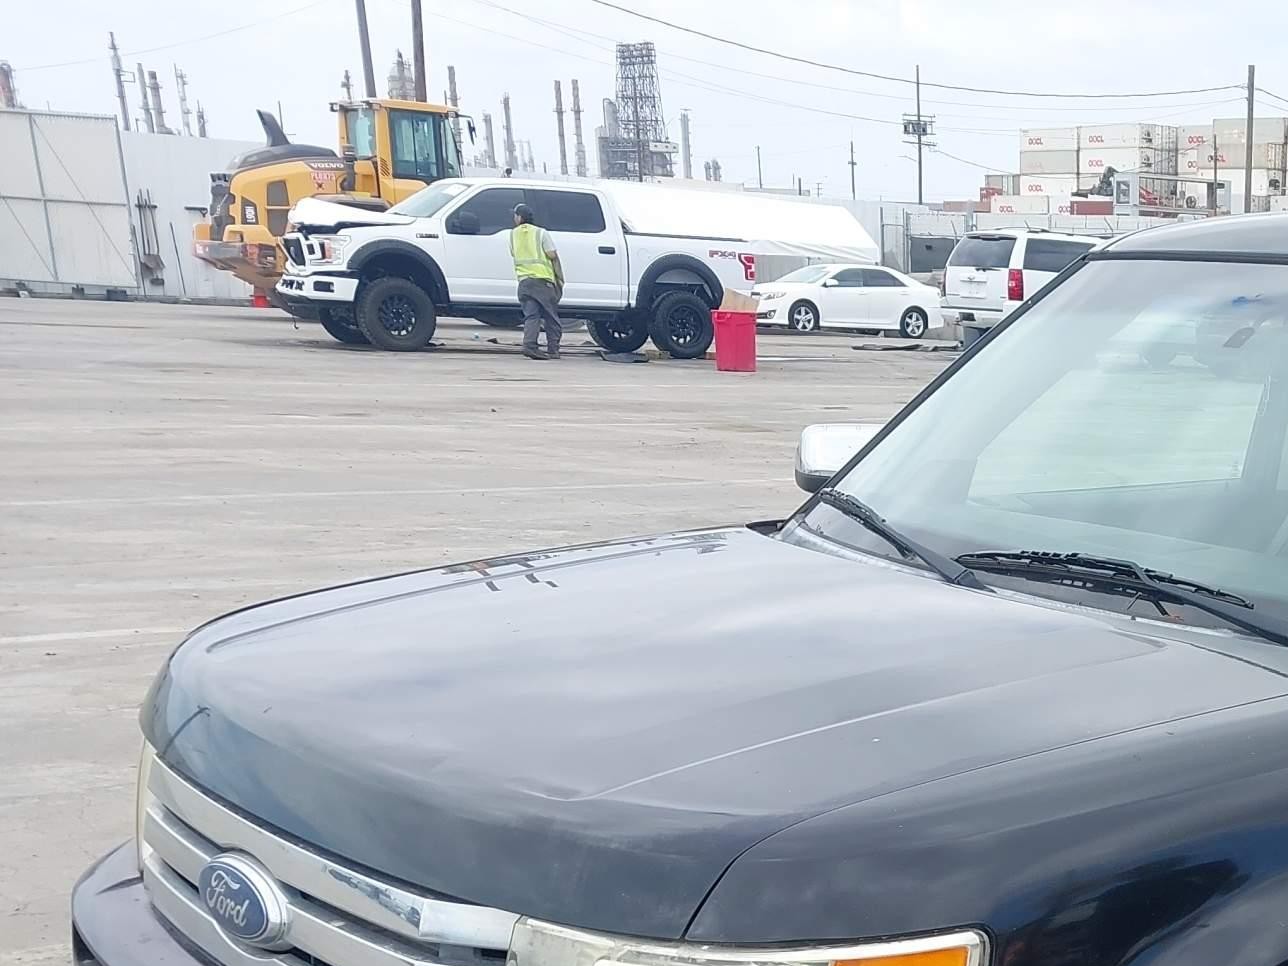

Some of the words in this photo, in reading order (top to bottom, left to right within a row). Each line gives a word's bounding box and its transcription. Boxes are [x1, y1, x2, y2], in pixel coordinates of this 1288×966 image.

[1028, 137, 1043, 145] OOCL
[1088, 135, 1104, 143] OOCL
[1188, 135, 1206, 144] OOCL
[1028, 184, 1043, 192] OOCL
[1058, 205, 1071, 213] OOC
[708, 250, 736, 259] FX4
[206, 870, 250, 927] Ford
